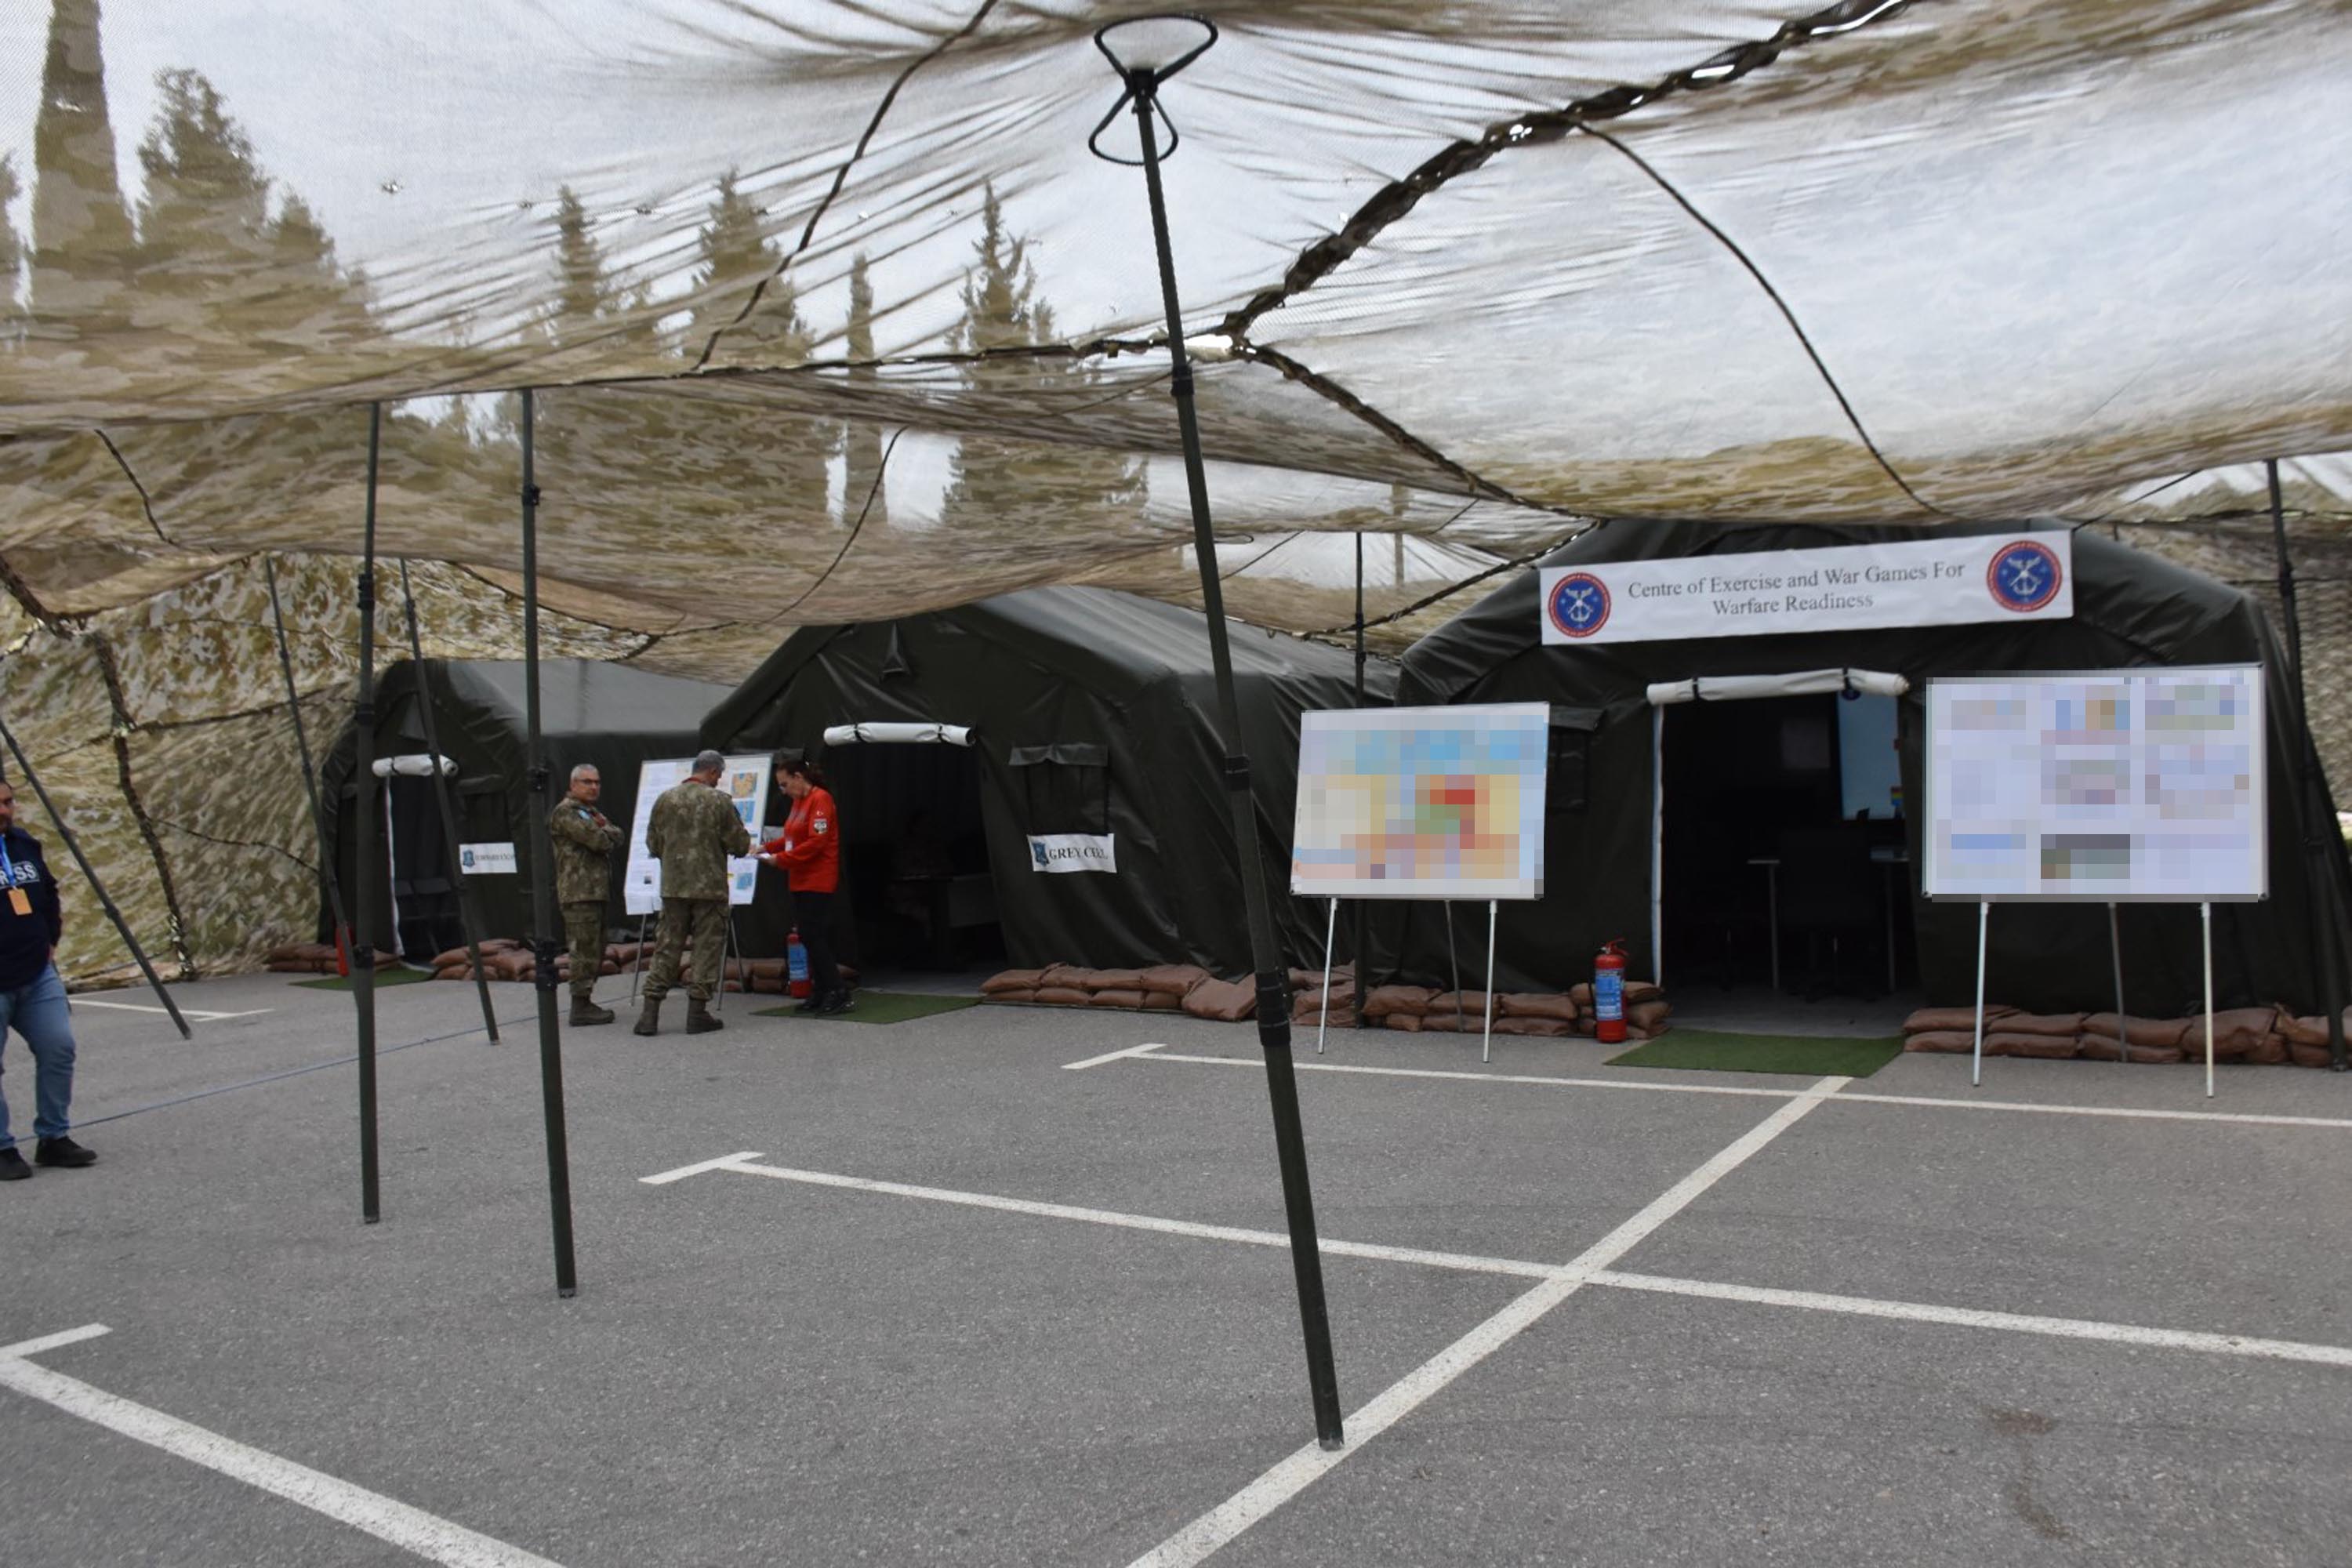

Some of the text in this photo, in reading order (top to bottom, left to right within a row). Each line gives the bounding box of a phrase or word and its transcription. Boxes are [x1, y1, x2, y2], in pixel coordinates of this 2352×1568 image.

[1628, 561, 1966, 599] Centre of Exercise and War Games For
[1712, 593, 1874, 615] Warfare Readiness
